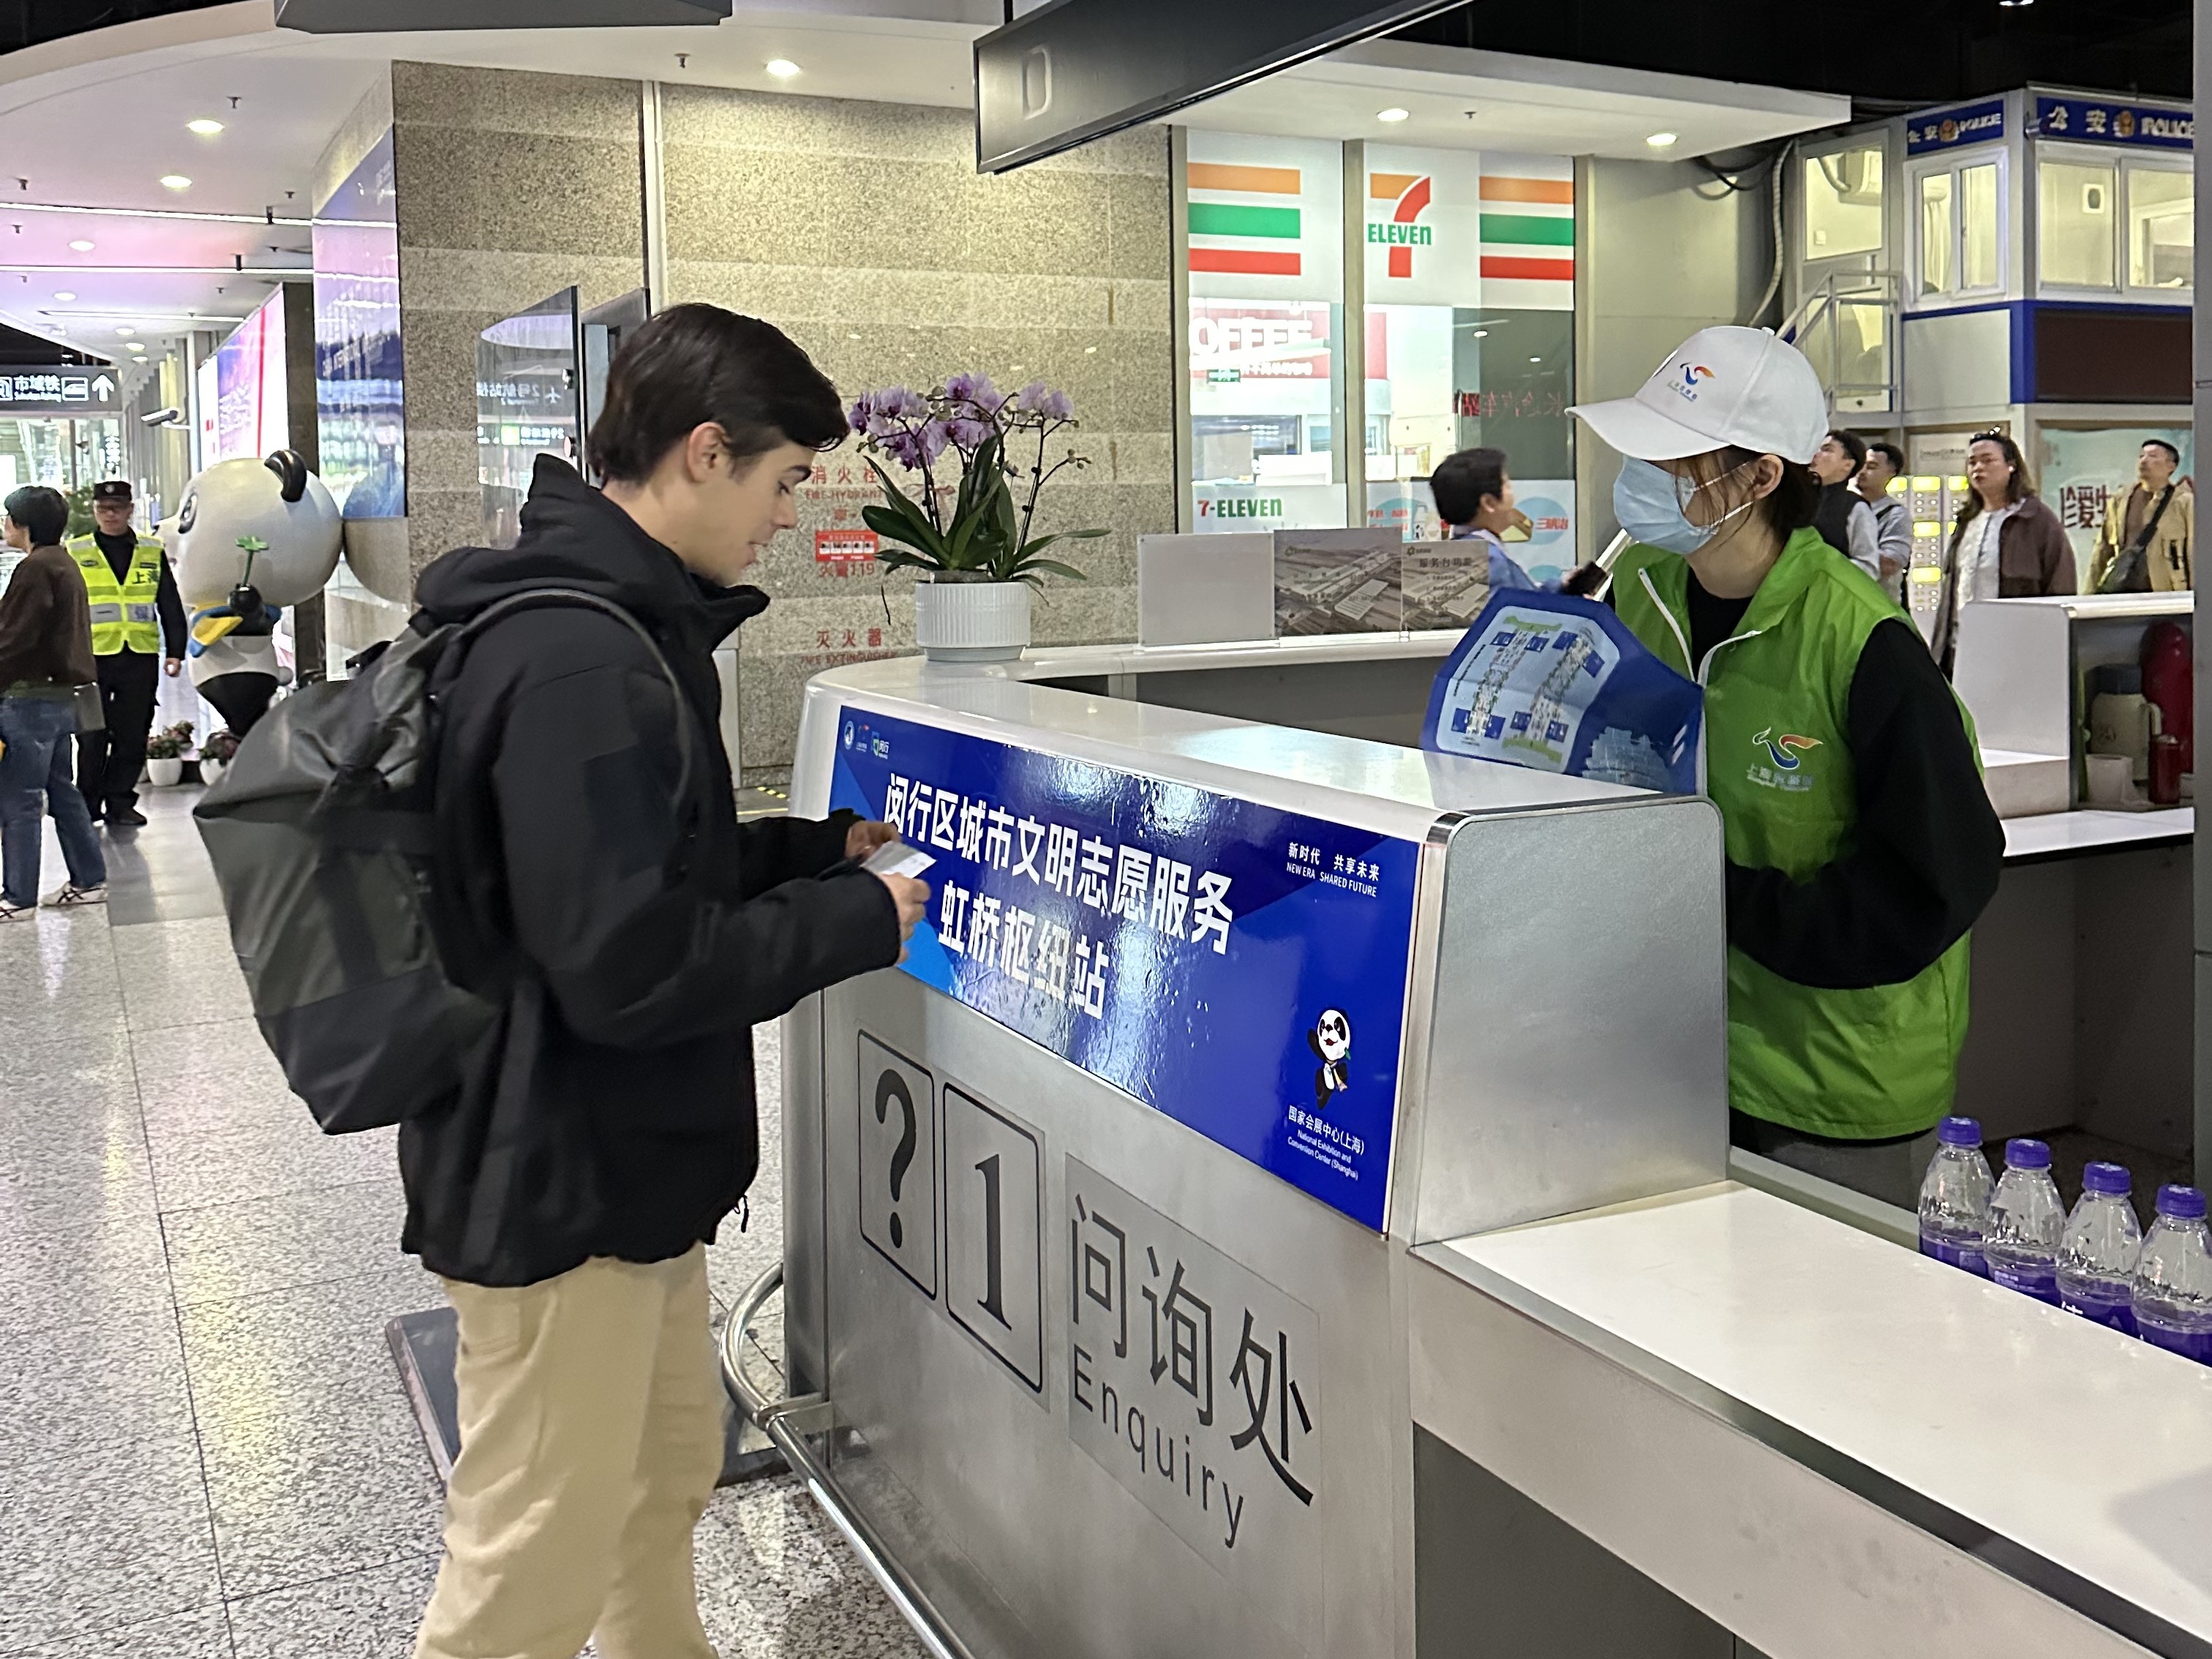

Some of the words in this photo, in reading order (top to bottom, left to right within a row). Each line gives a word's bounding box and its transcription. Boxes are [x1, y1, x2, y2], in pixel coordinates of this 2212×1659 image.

[1960, 113, 2001, 132] POLICE
[14, 375, 61, 391] 市域铁
[812, 465, 877, 484] 消火栓
[816, 628, 881, 649] 灭火器
[884, 773, 1233, 955] 闵行区城市文明志愿服务
[1287, 862, 1301, 875] NEW
[1303, 867, 1315, 879] ERA
[1320, 871, 1347, 888] SHARED
[1349, 880, 1377, 898] FUTURE
[1289, 841, 1320, 865] 新时代
[1333, 854, 1380, 881] 共享未来
[938, 880, 1109, 1020] 虹桥枢纽站
[1288, 1137, 1314, 1156] Convention
[1331, 1159, 1358, 1181] (Shanghai)
[1298, 1129, 1317, 1146] National
[1318, 1140, 1341, 1158] Exhibition
[1342, 1154, 1351, 1164] and
[975, 1154, 1012, 1331] 1
[1072, 1194, 1313, 1506] 问询处
[1075, 1344, 1244, 1548] Enquiry
